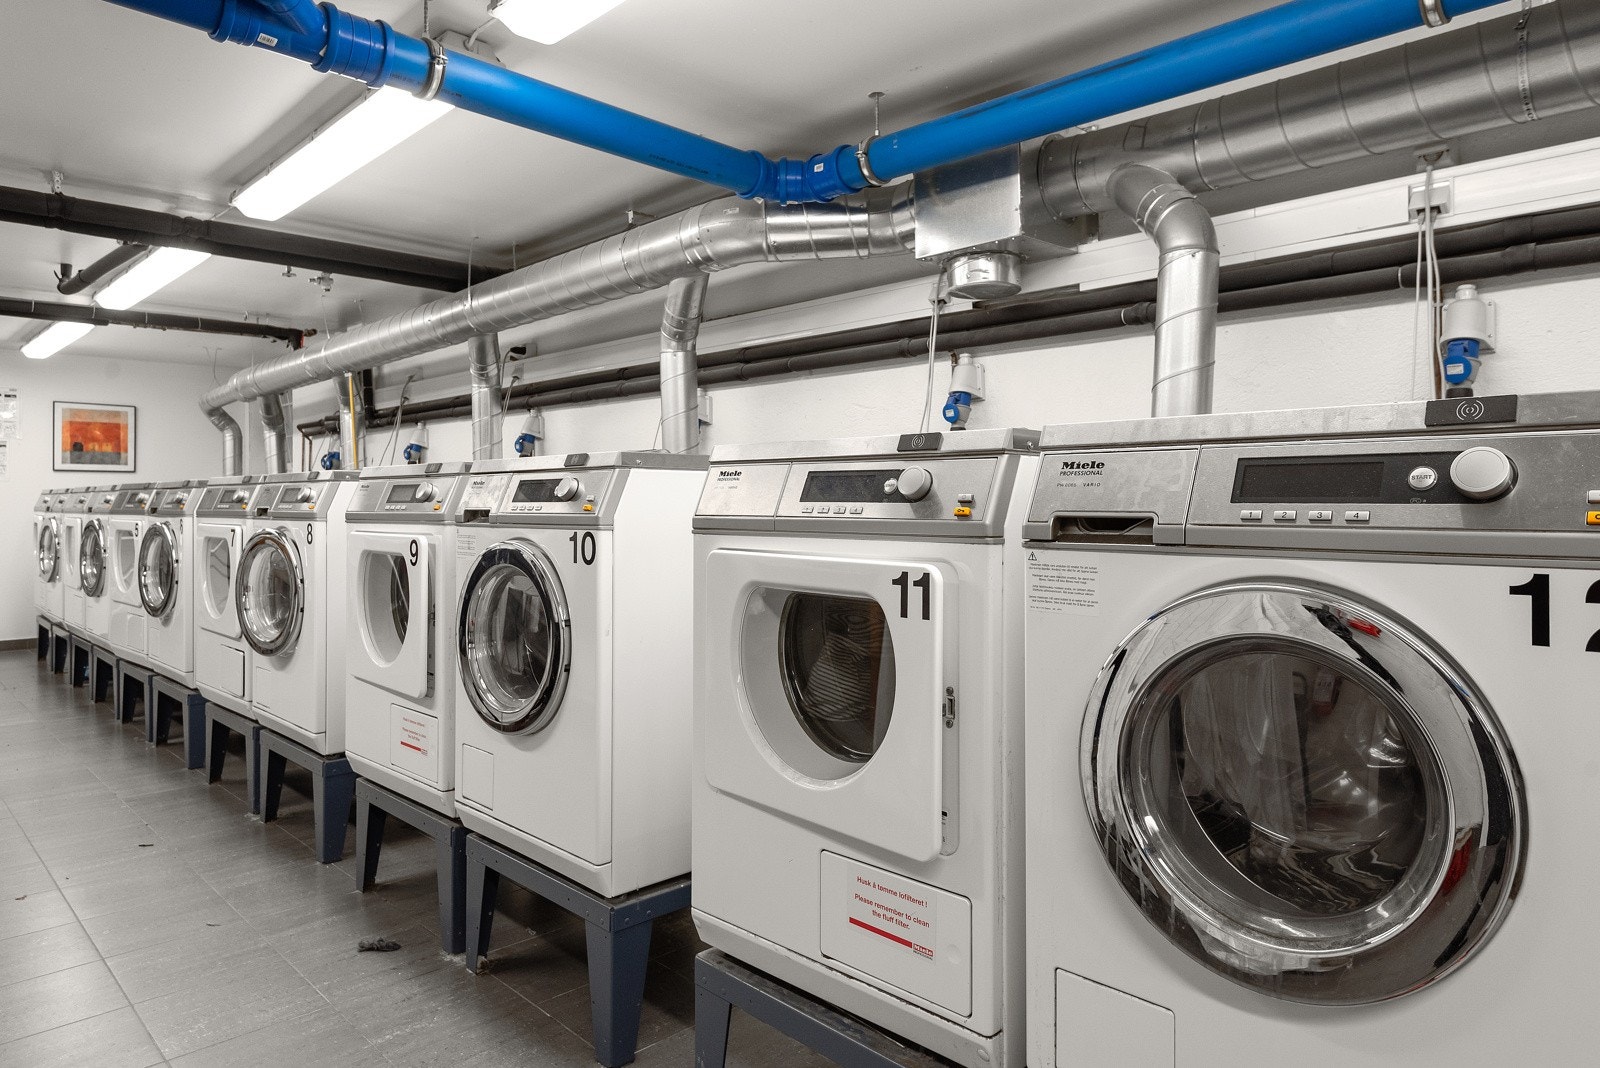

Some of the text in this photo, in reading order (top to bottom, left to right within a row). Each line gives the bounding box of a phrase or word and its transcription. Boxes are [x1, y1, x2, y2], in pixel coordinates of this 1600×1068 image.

[1061, 461, 1105, 470] Miele
[1281, 511, 1288, 519] 2
[1316, 511, 1323, 519] 3
[230, 528, 236, 547] 7
[306, 522, 313, 545] 8
[409, 539, 419, 567] 9
[569, 531, 597, 566] 10
[891, 571, 931, 621] 11
[857, 876, 871, 887] Husk
[877, 884, 898, 897] tomme
[854, 893, 930, 928] Please remember to clean
[872, 909, 882, 919] the
[882, 913, 895, 924] fluff
